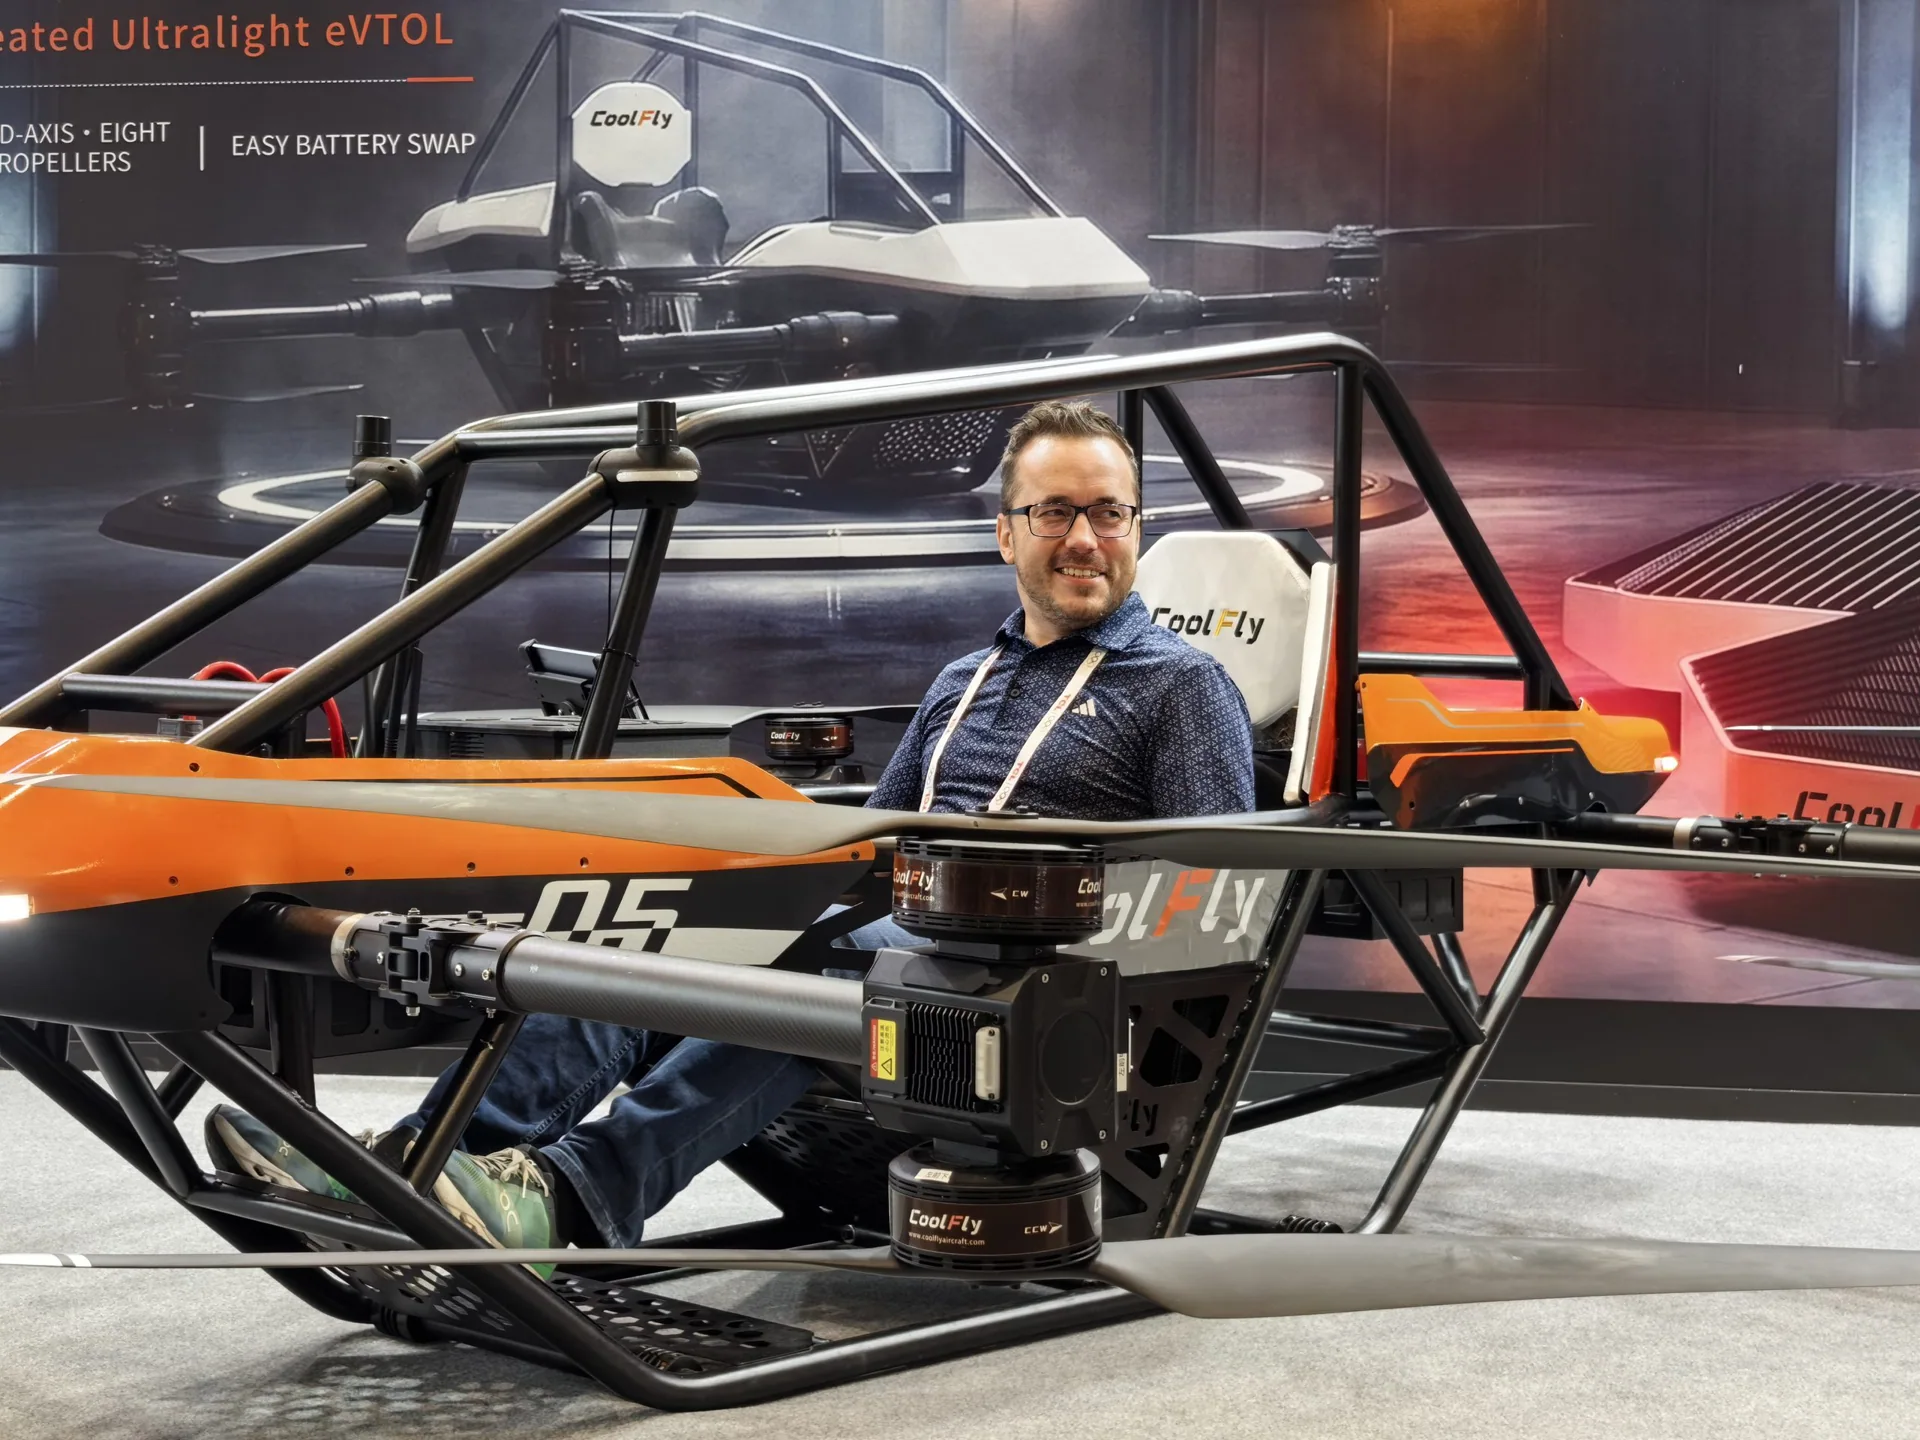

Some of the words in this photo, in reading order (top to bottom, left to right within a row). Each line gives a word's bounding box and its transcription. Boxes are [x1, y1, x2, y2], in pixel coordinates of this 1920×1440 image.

[0, 18, 93, 51] ated
[113, 15, 309, 57] Ultralight
[326, 13, 453, 46] eVTOL
[590, 110, 672, 129] CoolFly
[0, 123, 74, 144] D-AXIS
[100, 122, 171, 142] EIGHT
[232, 135, 289, 156] EASY
[296, 134, 401, 156] BATTERY
[407, 133, 476, 155] SWAP
[770, 732, 800, 741] CoolFly
[1012, 889, 1029, 898] CW
[909, 1208, 983, 1235] CoolFly
[1024, 1224, 1048, 1235] CCW
[908, 1231, 985, 1246] www.coolflyaircraft.com
